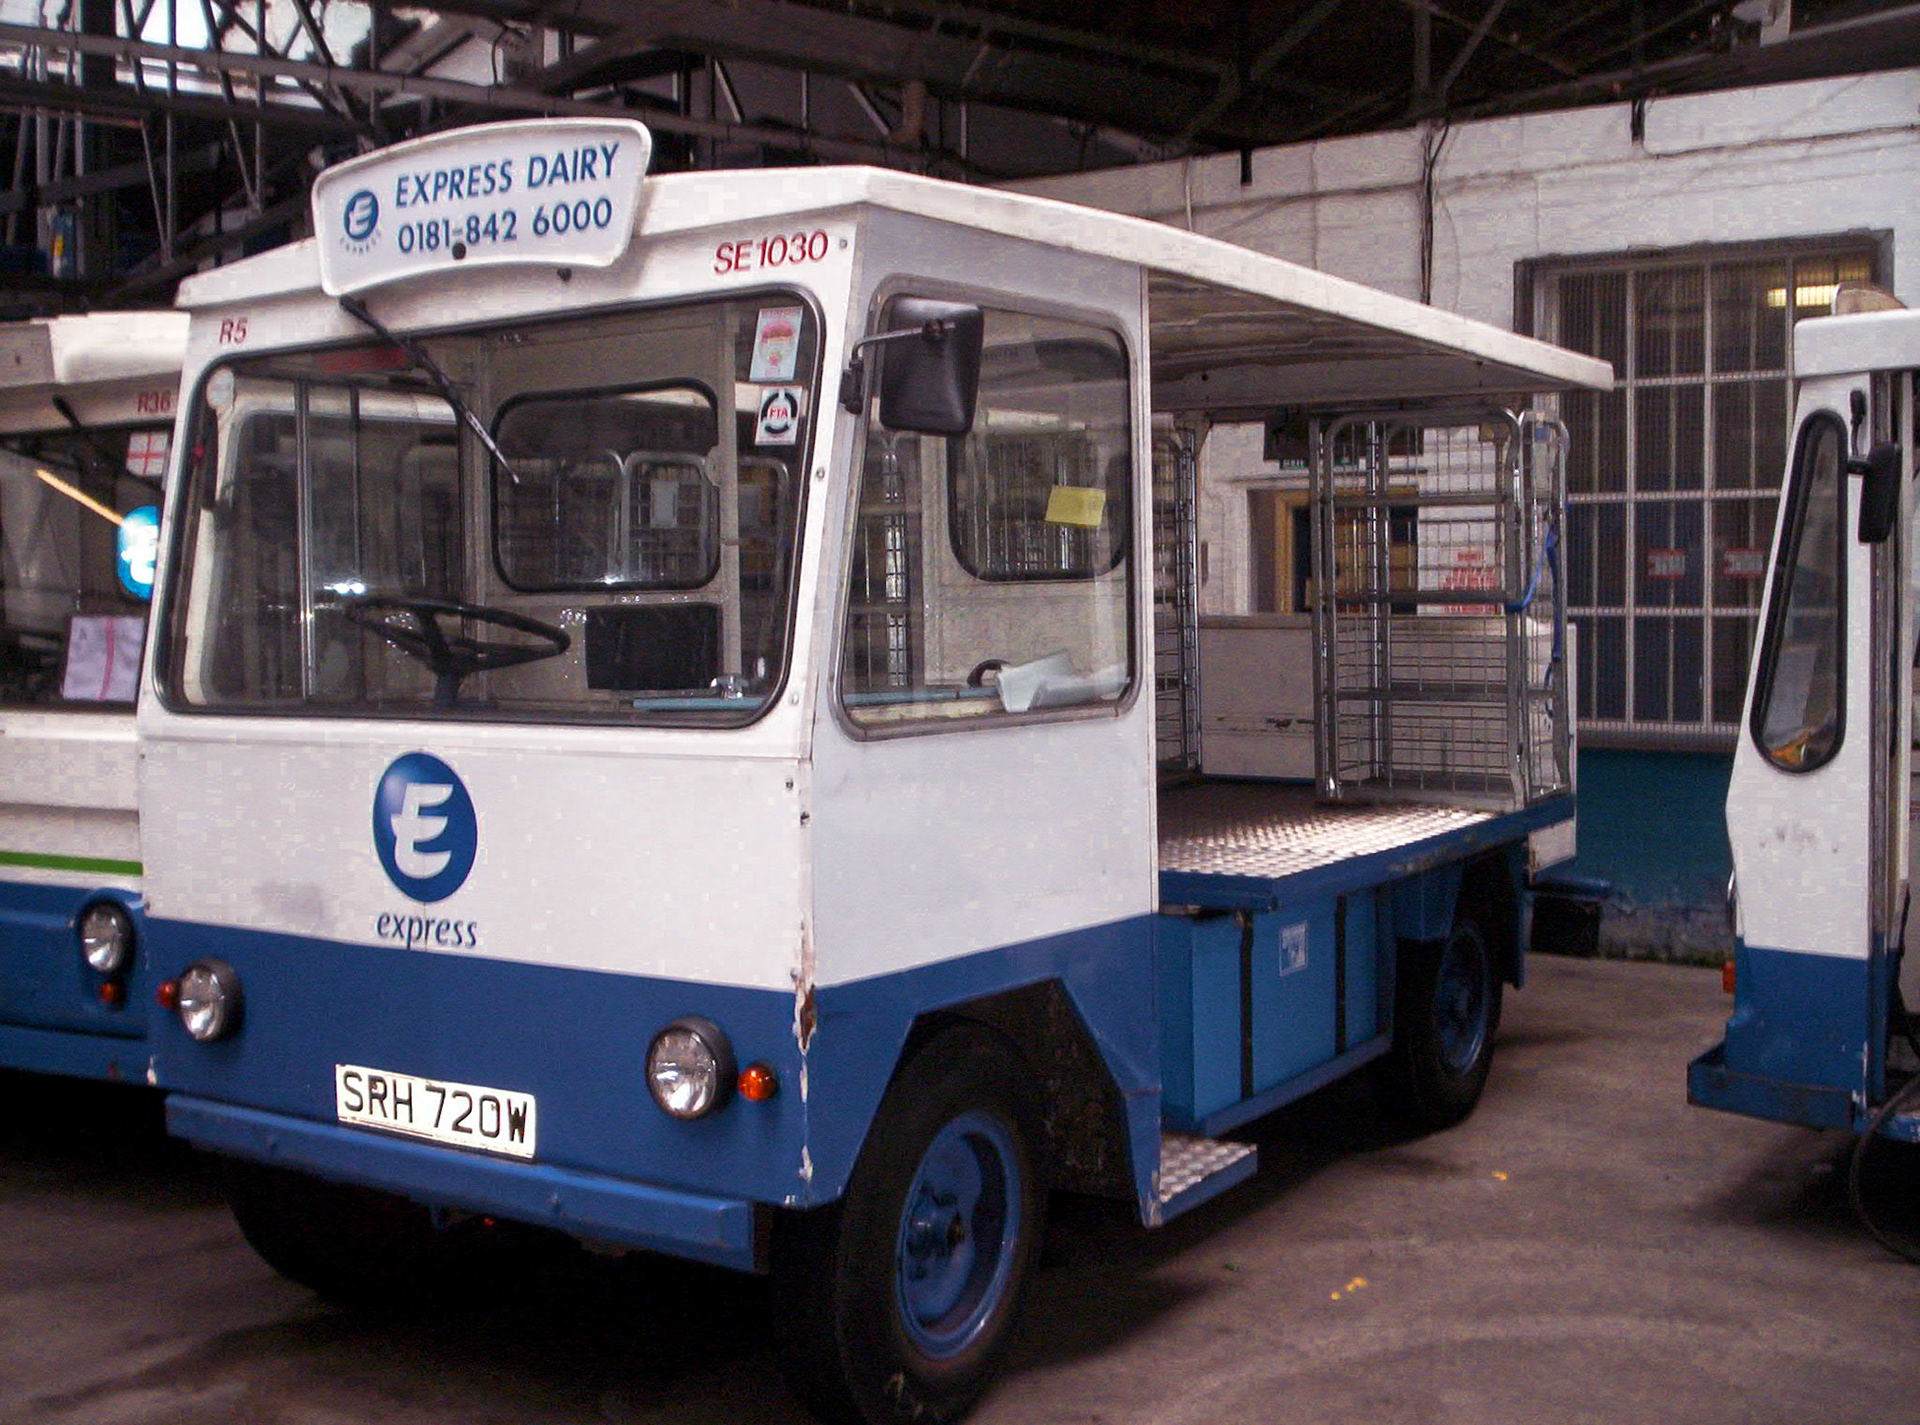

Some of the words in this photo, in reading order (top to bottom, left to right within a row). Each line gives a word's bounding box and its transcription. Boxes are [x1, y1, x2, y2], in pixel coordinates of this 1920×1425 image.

[395, 160, 513, 208] EXPRESS
[526, 143, 620, 189] DAIRY
[398, 211, 516, 252] 0181-842
[532, 197, 613, 236] 6000
[218, 317, 248, 344] R5
[376, 911, 478, 950] express
[342, 1070, 414, 1124] SRH
[425, 1085, 527, 1143] 720W
